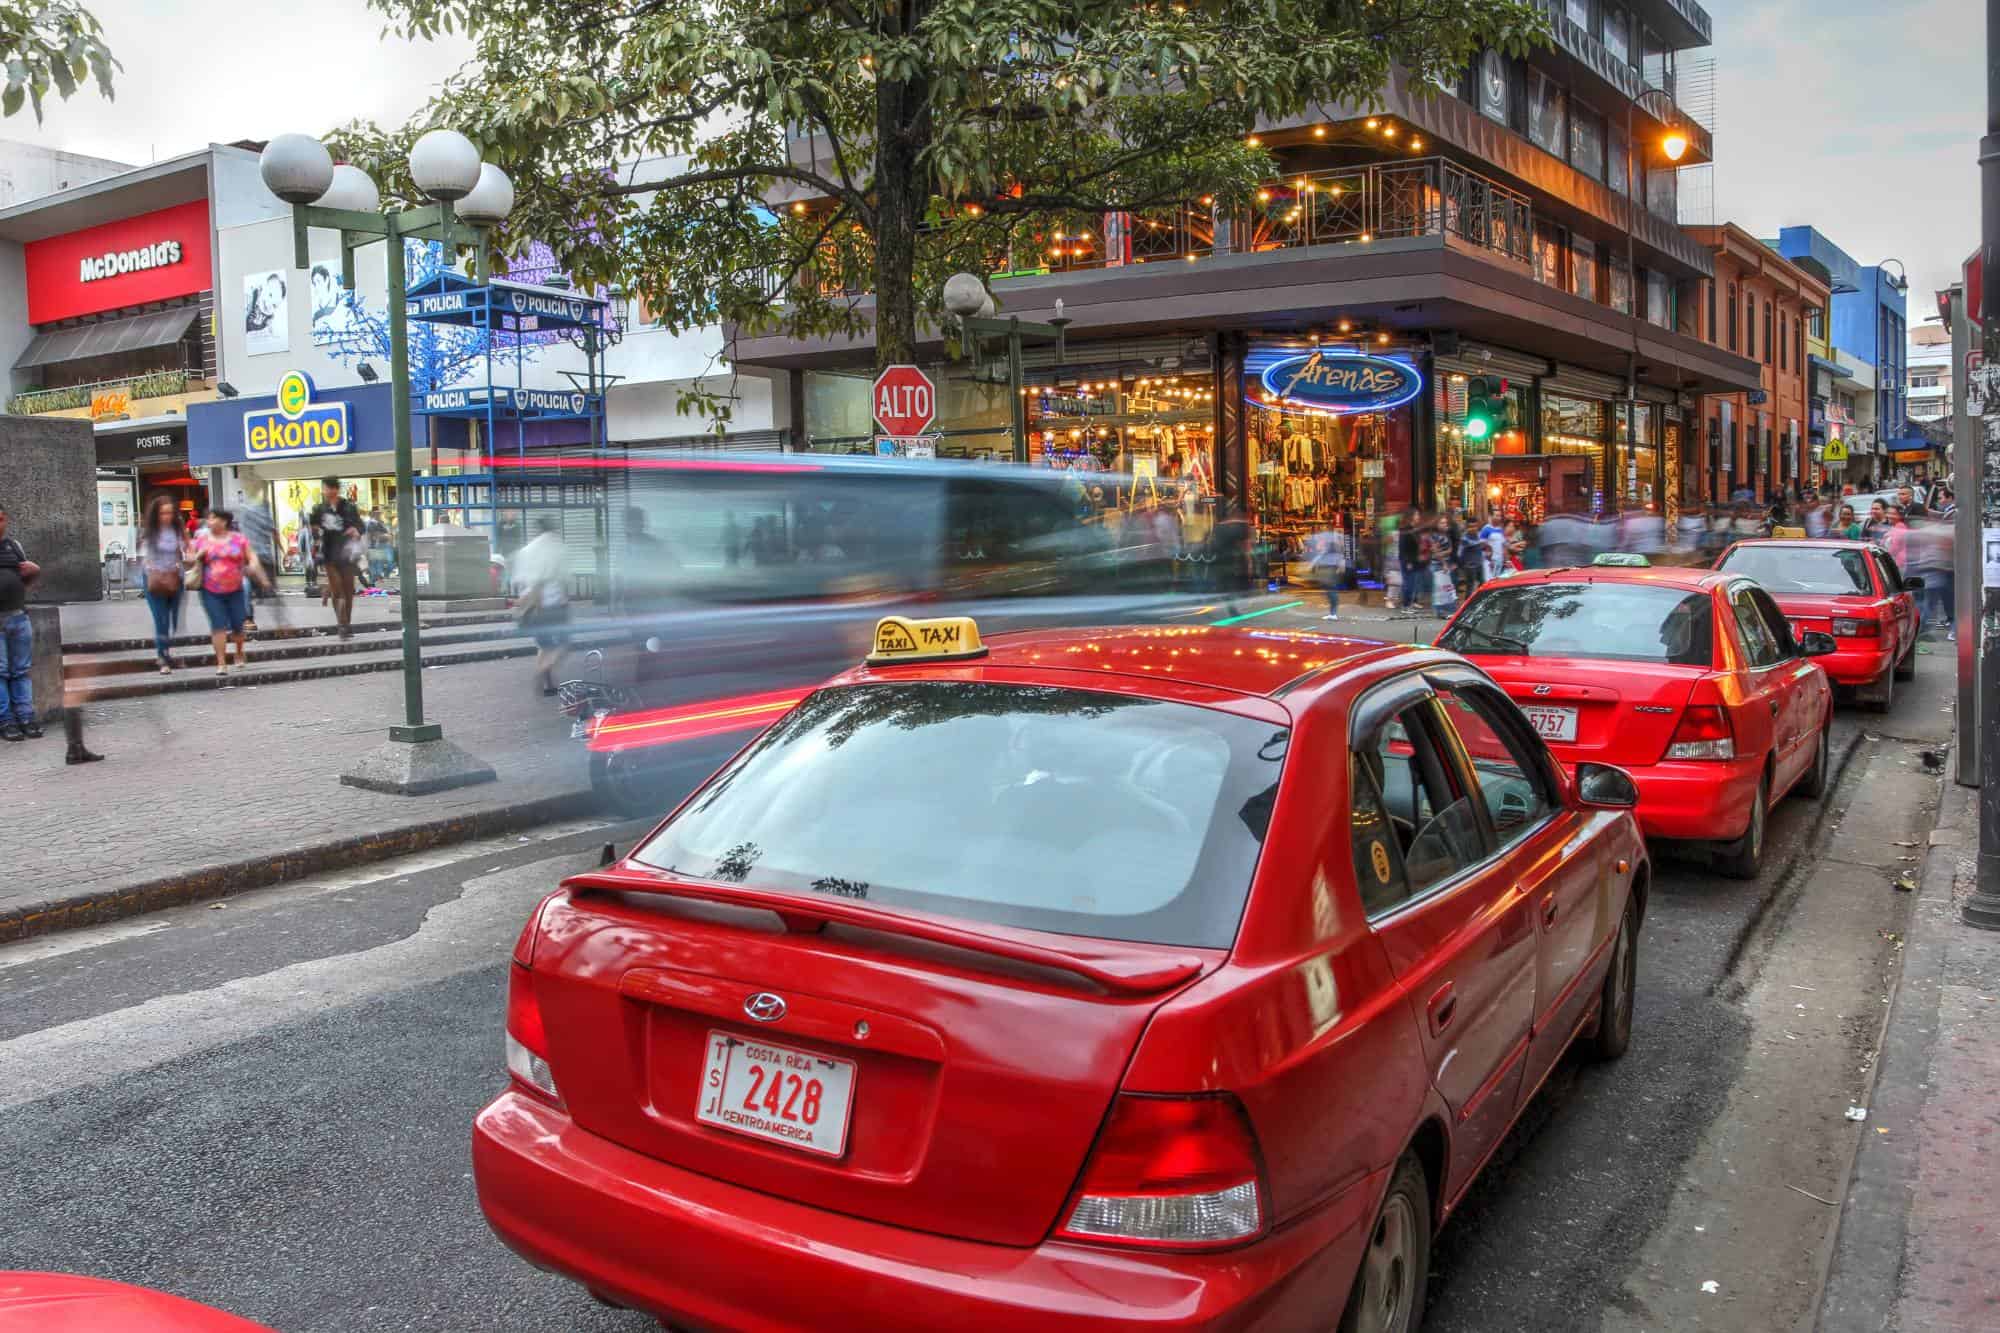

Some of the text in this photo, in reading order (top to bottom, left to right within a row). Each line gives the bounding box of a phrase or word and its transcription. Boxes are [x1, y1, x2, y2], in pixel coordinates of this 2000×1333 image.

[80, 240, 181, 282] McDonald's
[1280, 351, 1402, 398] Arenas
[879, 384, 929, 418] ALTO
[136, 434, 171, 449] POSTRES
[250, 416, 341, 451] ekono
[880, 638, 908, 649] TAXI
[920, 625, 960, 645] TAXI
[746, 1046, 812, 1073] COSTA RICA
[743, 1064, 824, 1126] 2428
[722, 1109, 814, 1143] CENTROAMERICA
